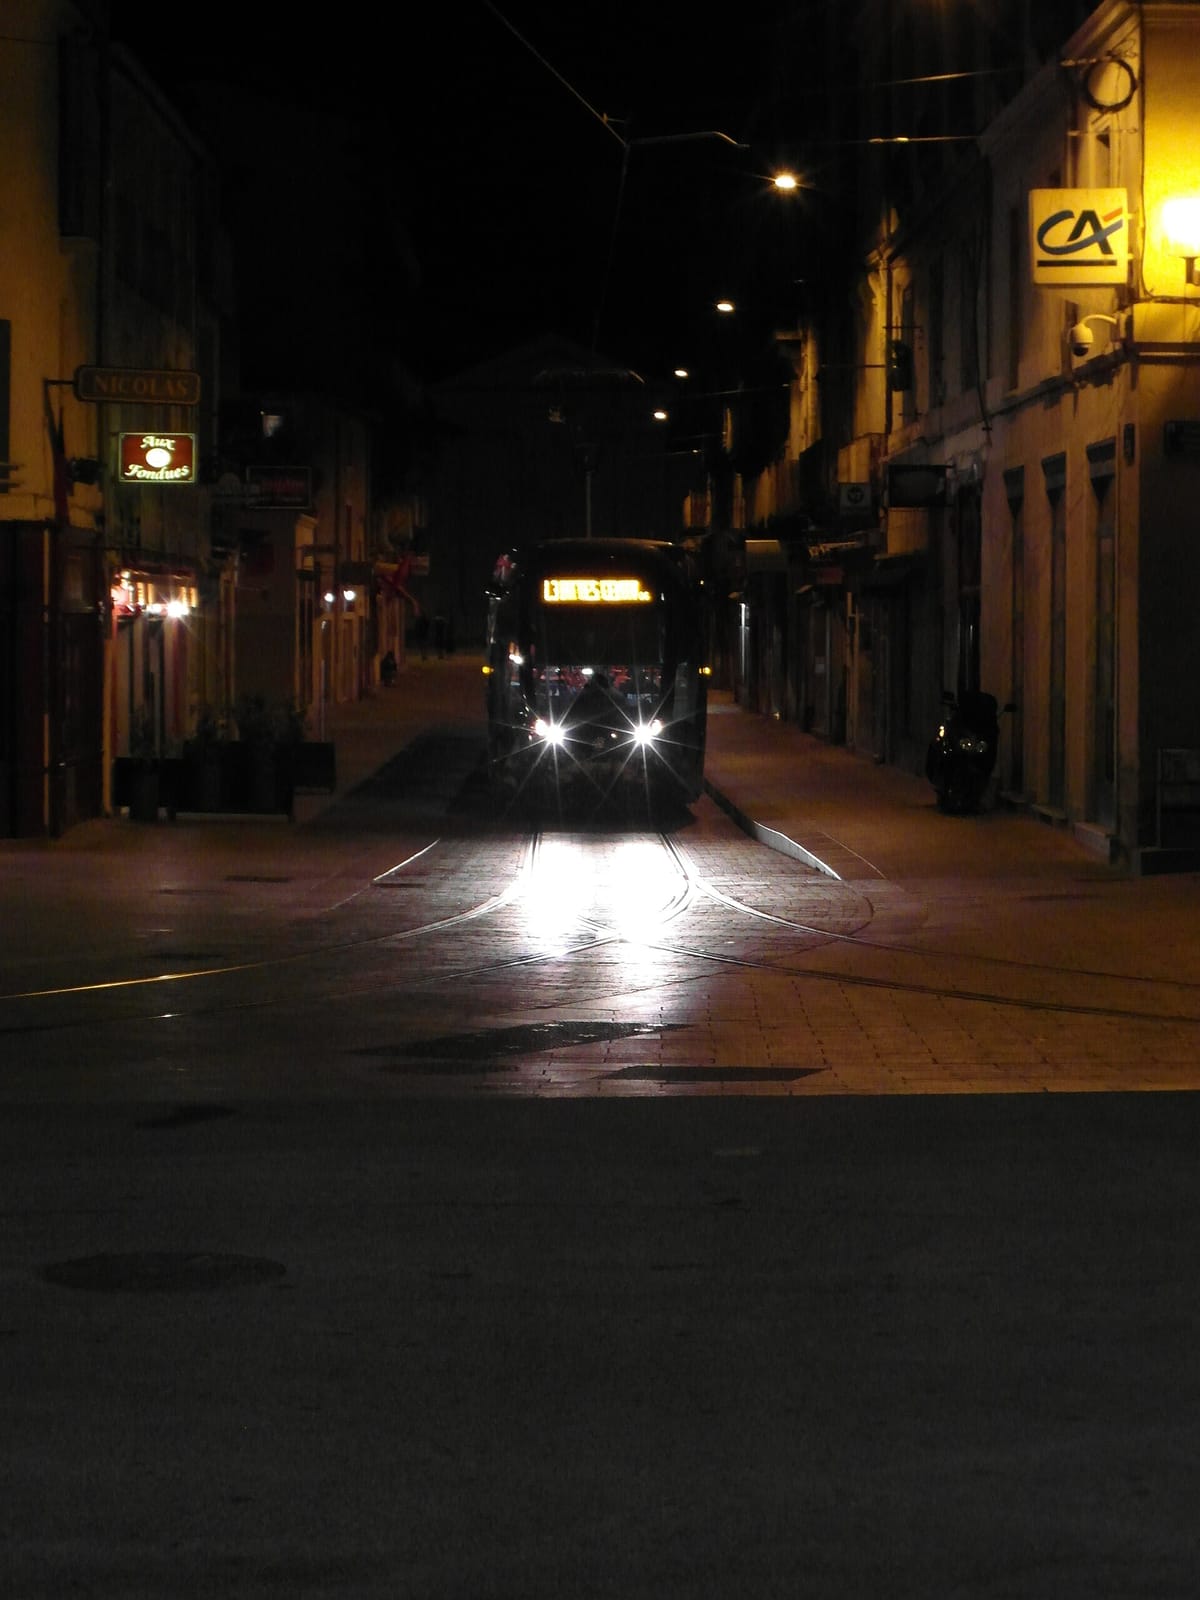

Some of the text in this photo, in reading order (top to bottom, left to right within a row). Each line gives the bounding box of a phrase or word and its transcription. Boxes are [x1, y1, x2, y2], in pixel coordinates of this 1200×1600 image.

[1037, 209, 1123, 255] CA
[95, 375, 188, 396] NICOLAS
[140, 435, 176, 450] Aux
[124, 463, 190, 481] Fondues
